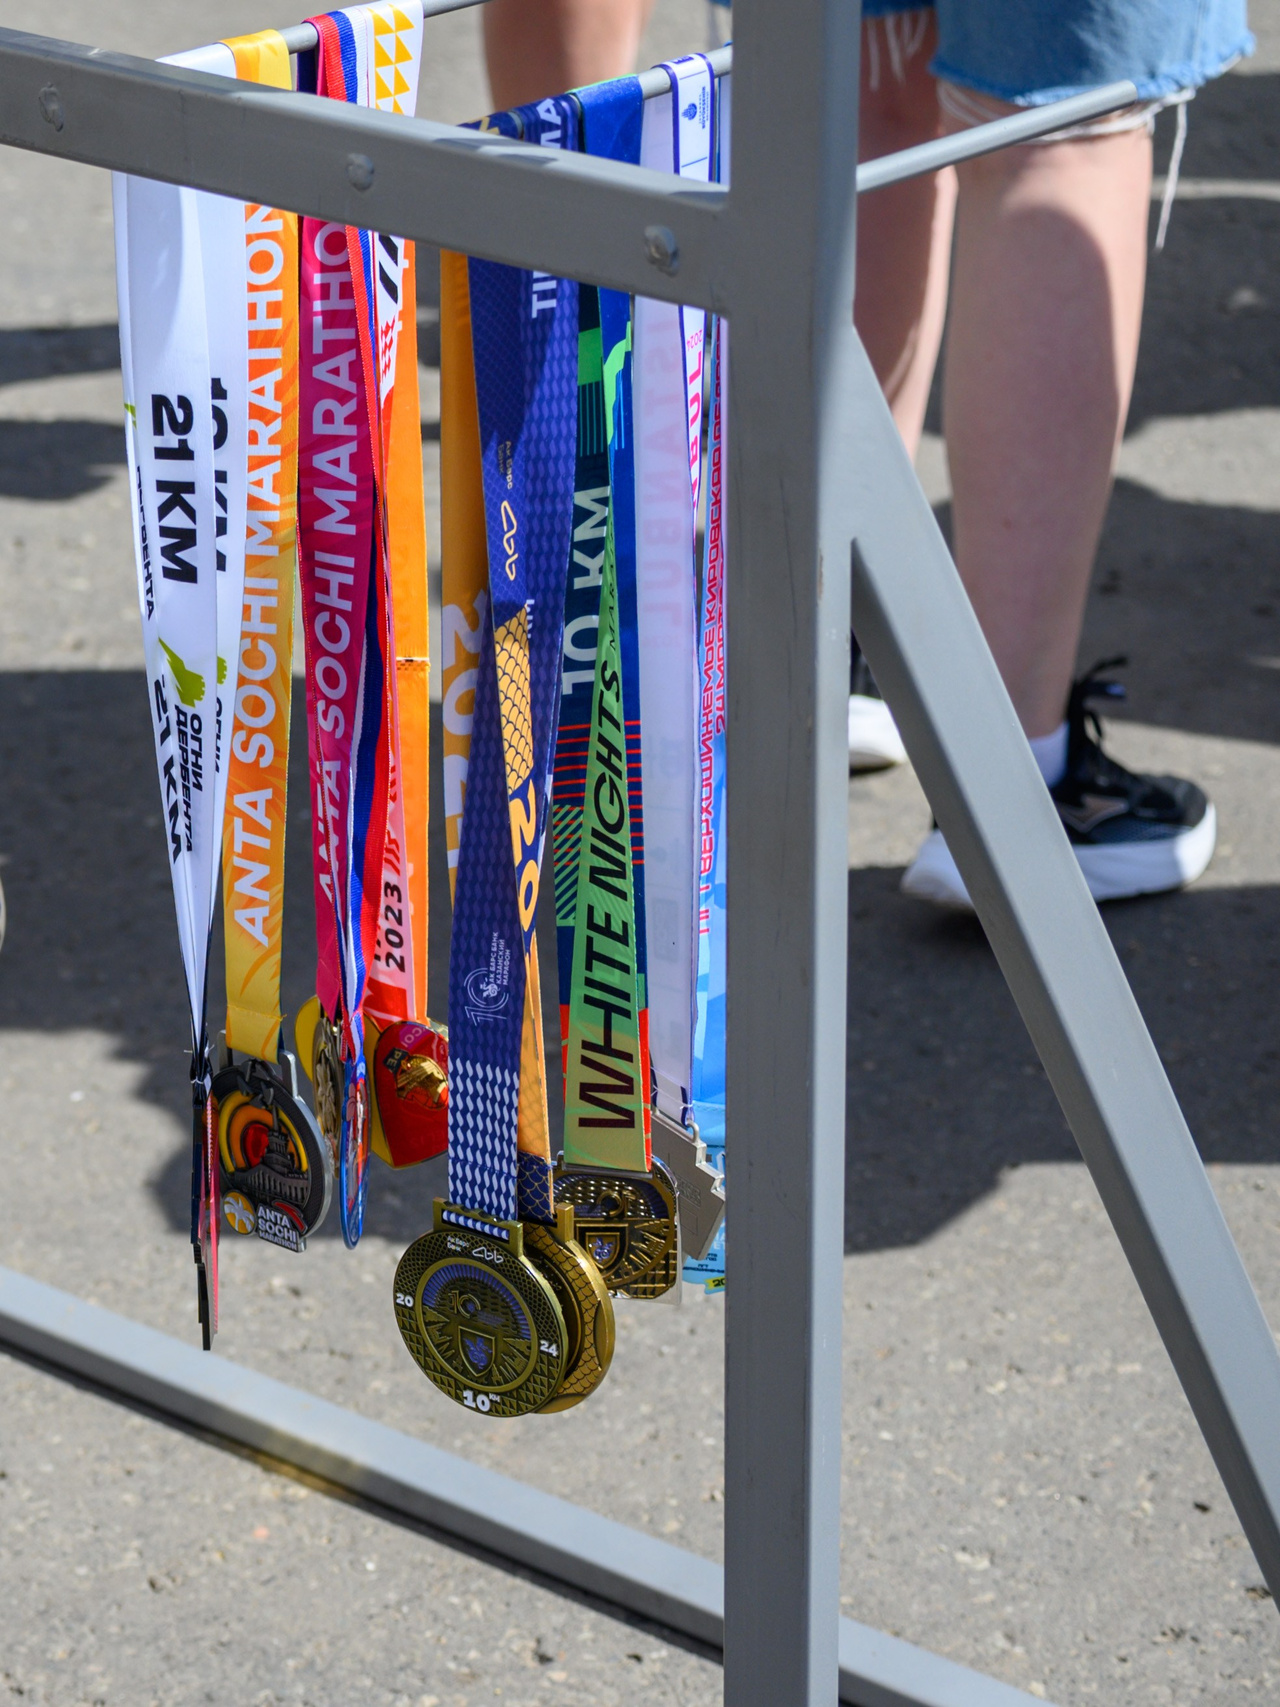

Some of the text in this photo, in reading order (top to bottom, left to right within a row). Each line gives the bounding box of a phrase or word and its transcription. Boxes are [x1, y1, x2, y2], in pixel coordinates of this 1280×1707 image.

[311, 222, 358, 537] MARATHO
[151, 393, 195, 461] 21
[231, 203, 284, 947] ANTA SOCHI MARATHON
[313, 556, 356, 740] SOCHI
[562, 614, 601, 695] 10
[175, 703, 194, 852] ДЕРБЕНТА
[190, 712, 204, 792] ОГНИ
[588, 659, 629, 888] NIGHTS
[383, 880, 406, 974] 2023
[577, 901, 636, 1131] WHITE
[257, 1205, 291, 1229] ANTA
[258, 1217, 298, 1243] SOCHI
[395, 1292, 415, 1308] 20
[539, 1340, 559, 1358] 24
[462, 1389, 491, 1413] 10
